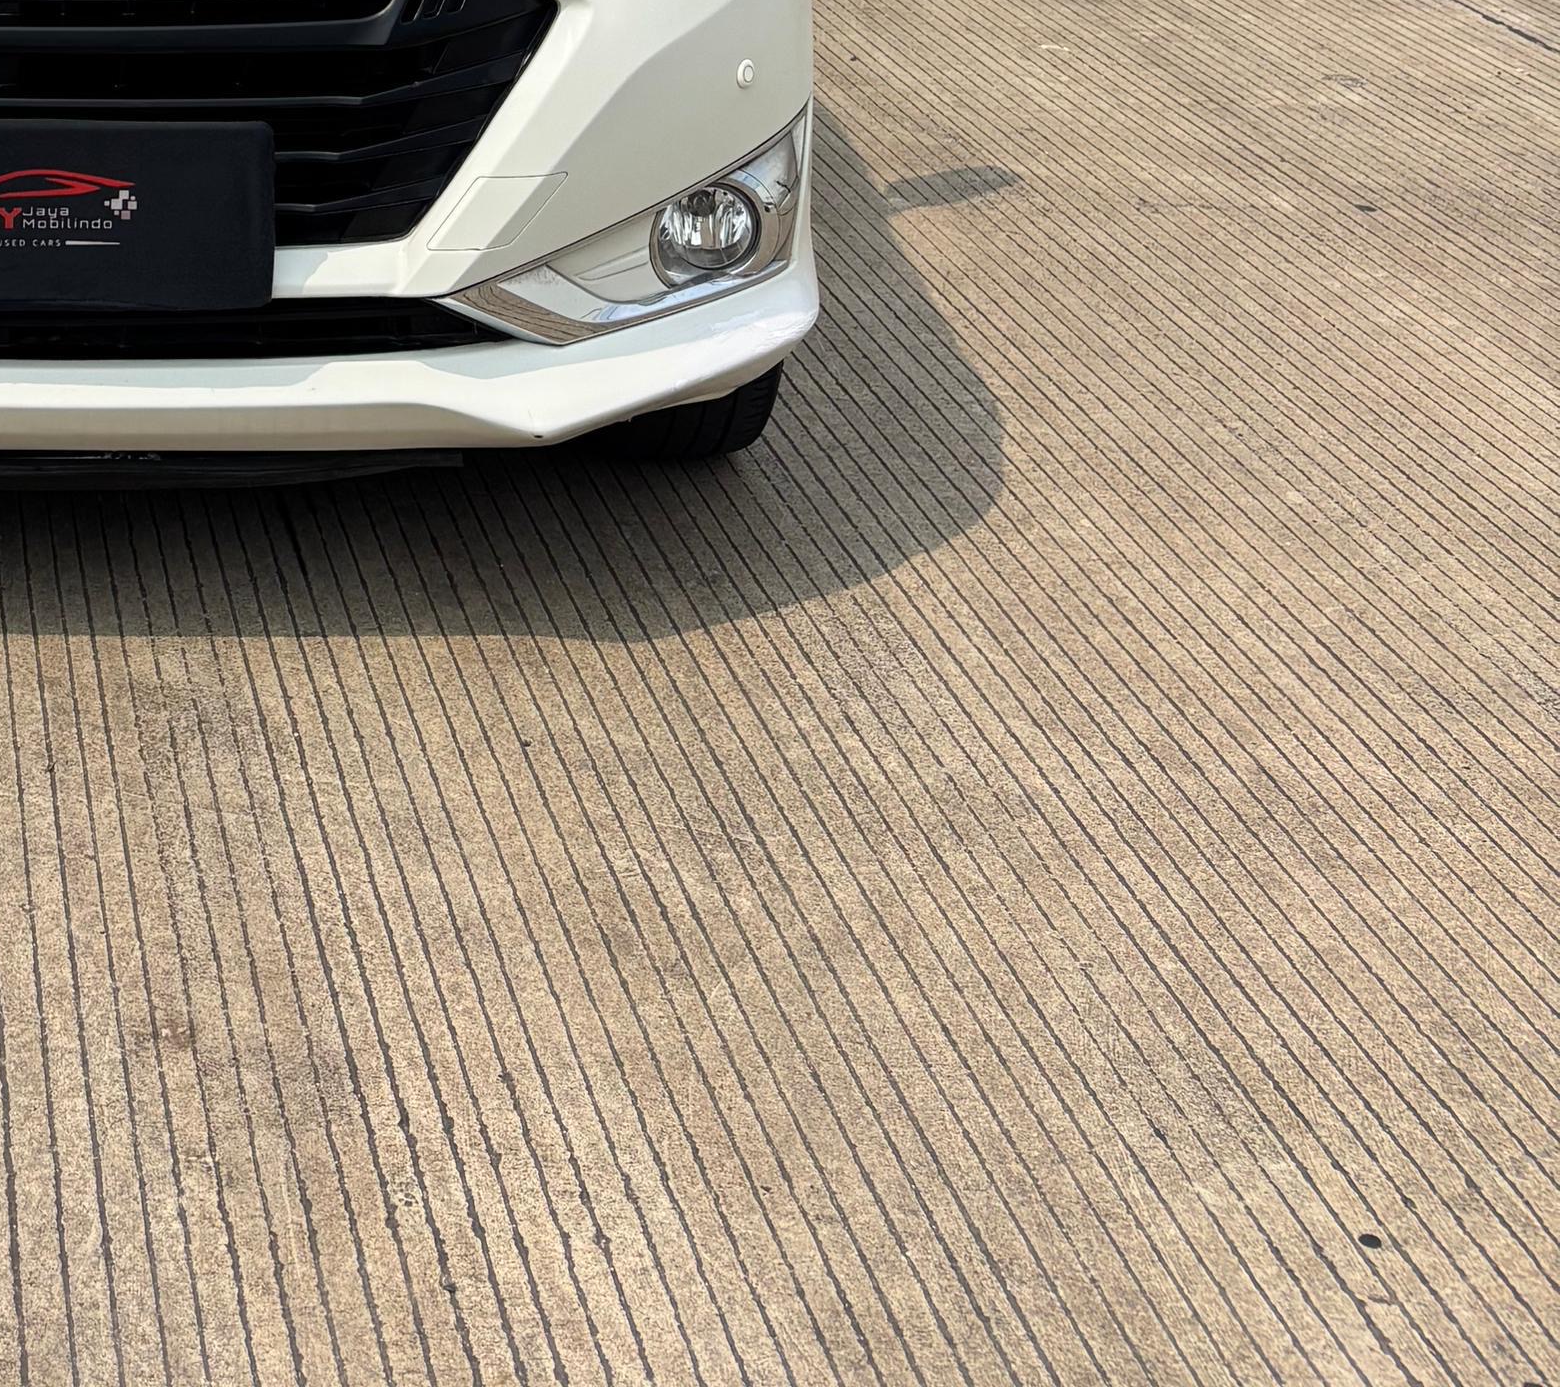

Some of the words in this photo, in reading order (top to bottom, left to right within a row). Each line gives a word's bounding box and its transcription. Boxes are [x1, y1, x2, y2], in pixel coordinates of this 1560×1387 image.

[22, 206, 69, 218] Jaya
[22, 218, 113, 229] Mobilindo
[32, 239, 61, 247] CARS
